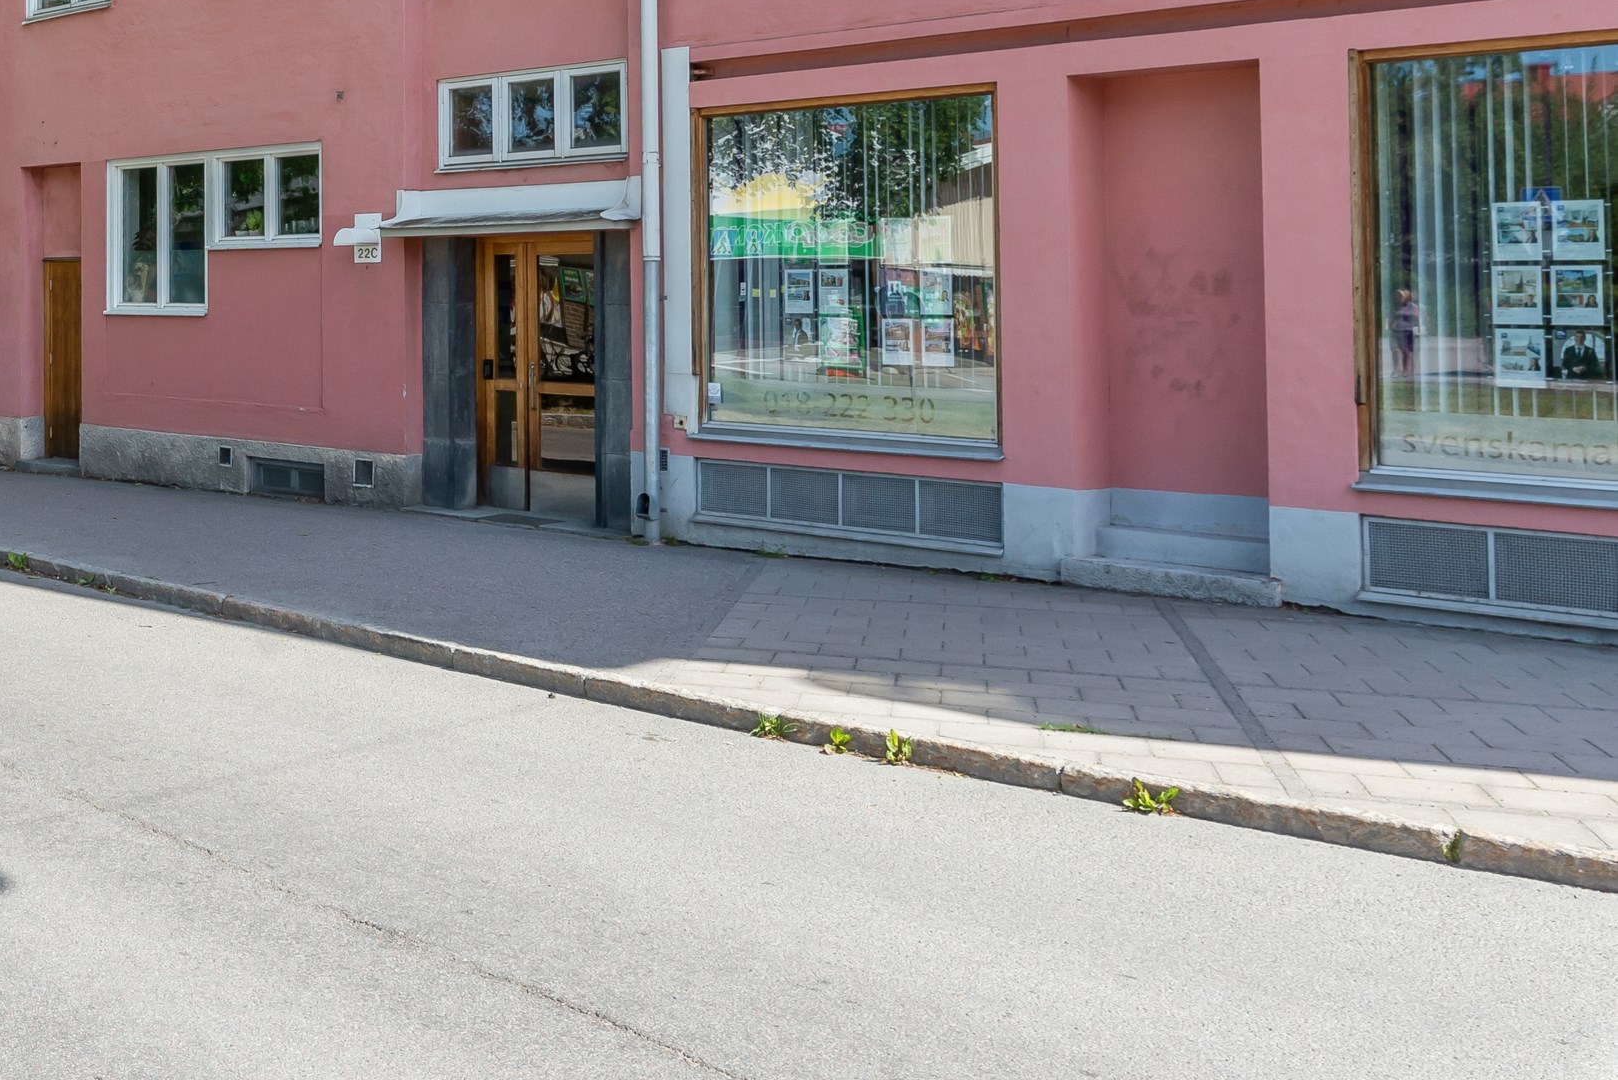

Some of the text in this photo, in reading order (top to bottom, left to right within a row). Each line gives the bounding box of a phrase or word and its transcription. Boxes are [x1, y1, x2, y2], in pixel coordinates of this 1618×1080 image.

[358, 247, 378, 259] 22C
[883, 395, 936, 424] 330
[1401, 431, 1618, 466] svenskama
